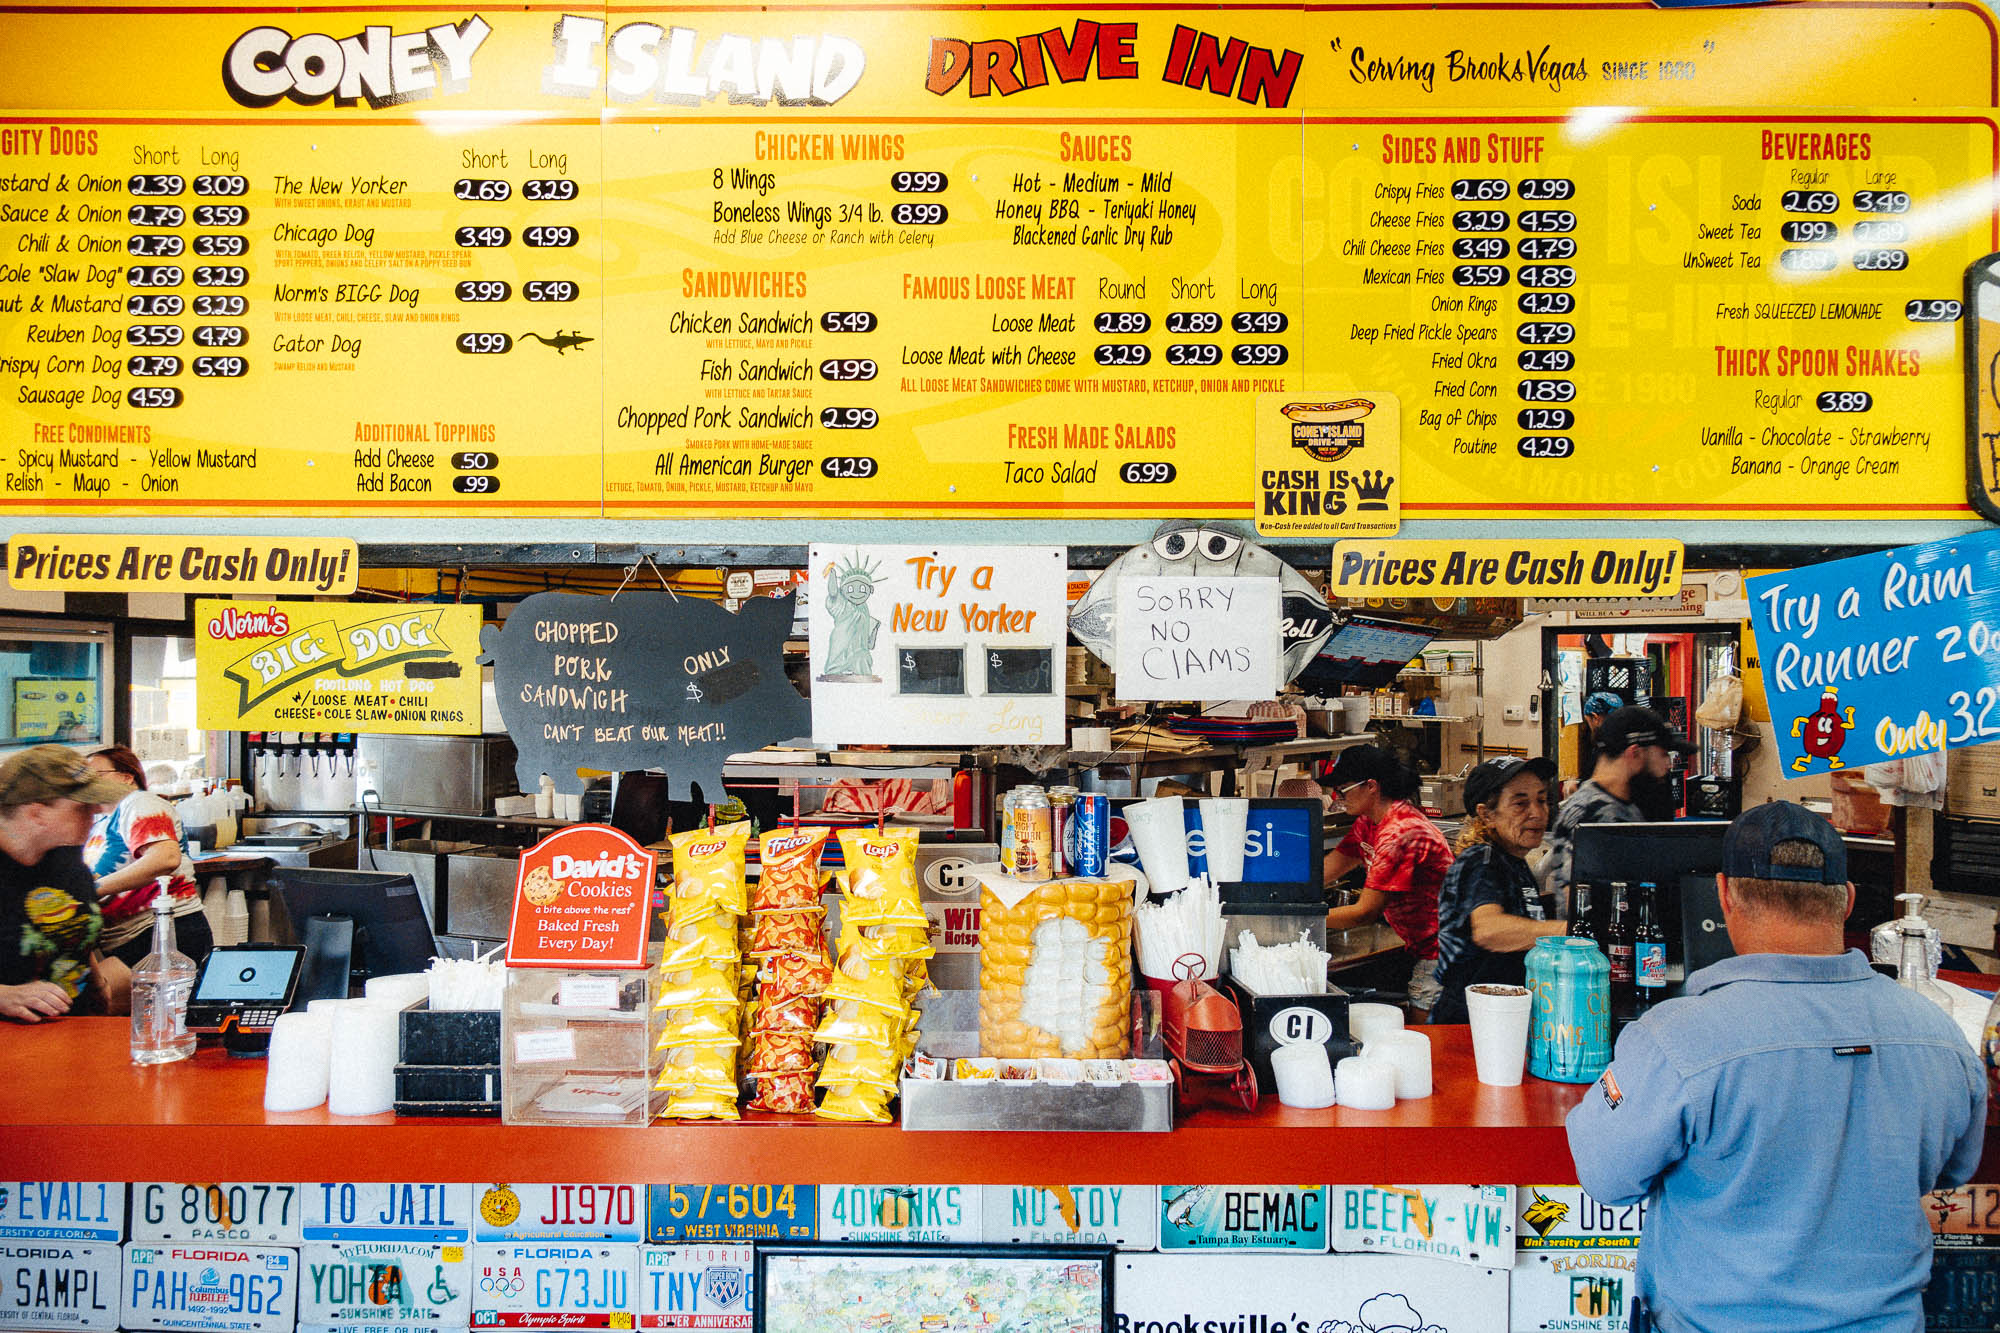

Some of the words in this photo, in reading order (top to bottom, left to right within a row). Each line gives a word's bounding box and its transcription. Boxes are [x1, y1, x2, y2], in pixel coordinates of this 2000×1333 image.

[223, 14, 492, 109] CONEY
[541, 14, 866, 107] ISLAND
[925, 19, 1138, 98] DRIVE
[1162, 24, 1303, 108] INN
[1602, 61, 1649, 81] SINCE
[51, 127, 98, 155] DOGS
[755, 131, 834, 160] CHICKEN
[842, 134, 905, 160] WINGS
[1060, 132, 1132, 162] SAUCES
[1383, 134, 1437, 164] SIDES
[1443, 138, 1480, 163] AND
[1488, 133, 1544, 163] STUFF
[1762, 130, 1871, 160] BEVERAGES
[274, 176, 302, 194] The
[310, 177, 342, 194] New
[351, 177, 408, 194] Yorker
[457, 180, 510, 200] 2.69
[528, 180, 573, 200] 3.29
[898, 205, 941, 223] 8.99
[1732, 195, 1761, 210] Soda
[1786, 193, 1838, 212] 2.69
[1855, 193, 1910, 212] 3.49
[714, 201, 780, 223] Boneless
[787, 203, 831, 229] Wings
[839, 204, 862, 222] 3/4
[869, 203, 884, 223] lb.
[18, 235, 50, 252] Chili
[57, 235, 69, 252] &
[78, 235, 122, 252] Onion
[714, 230, 735, 244] Add
[740, 230, 763, 244] Blue
[768, 230, 807, 244] Cheese
[813, 234, 825, 244] or
[830, 230, 864, 244] Ranch
[870, 230, 893, 244] with
[899, 230, 934, 248] Celery
[682, 268, 806, 297] SANDWICHES
[903, 274, 970, 300] FAMOUS
[976, 274, 1027, 300] LOOSE
[1031, 274, 1076, 300] MEAT
[1100, 277, 1146, 300] Round
[1171, 277, 1215, 298] Short
[1241, 278, 1277, 305] Long
[274, 285, 328, 302] Norm's
[336, 285, 382, 302] BIGG
[390, 284, 419, 307] Dog
[1351, 324, 1378, 344] Deep
[1384, 324, 1414, 340] Fried
[1419, 324, 1452, 340] Pickle
[1457, 324, 1497, 344] Spears
[1520, 324, 1573, 343] 4.79
[1715, 346, 1770, 376] THICK
[1777, 346, 1838, 376] SPOON
[1846, 346, 1920, 376] SHAKES
[920, 377, 949, 393] LOOSE
[952, 377, 977, 393] MEAT
[980, 377, 1042, 393] SANDWICHES
[1045, 377, 1071, 393] COME
[1074, 377, 1099, 393] WITH
[1101, 377, 1150, 395] MUSTARD,
[1153, 377, 1197, 395] KETCHUP,
[1200, 377, 1229, 393] ONION
[1232, 377, 1250, 393] AND
[1253, 377, 1285, 393] PICKLE
[355, 422, 430, 442] ADDITIONAL
[434, 422, 496, 442] TOPPINGS
[1262, 471, 1318, 489] CASH
[1329, 470, 1349, 489] IS
[1264, 491, 1347, 515] KING
[1304, 522, 1323, 530] added
[1324, 522, 1329, 530] to
[1331, 522, 1339, 530] all
[1340, 522, 1355, 530] Card
[1357, 522, 1396, 530] Transactions
[15, 546, 109, 579] Prices
[117, 547, 172, 579] Are
[180, 547, 256, 580] Cash
[266, 548, 350, 591] Only!
[906, 557, 956, 598] Try
[973, 566, 993, 590] a
[1338, 551, 1436, 585] Prices
[1442, 552, 1499, 585] Are
[1506, 551, 1584, 585] Cash
[1592, 550, 1677, 593] Only!
[1137, 586, 1234, 612] SORRY
[1760, 584, 1820, 639] Try
[1838, 587, 1859, 619] a
[1884, 562, 1974, 611] Rum
[209, 607, 288, 639] Norm's
[892, 603, 948, 632] New
[961, 603, 1036, 633] Yorker
[535, 621, 618, 643] CHOPPED
[1151, 621, 1190, 642] NO
[251, 630, 330, 687] BIG
[350, 617, 432, 663] DOG
[684, 646, 730, 675] ONLY
[1775, 635, 1919, 692] Runner
[555, 654, 612, 682] PORK
[521, 684, 628, 713] SANDWICH
[544, 724, 584, 743] CAN'T
[595, 725, 634, 742] BEAT
[642, 725, 669, 741] OUR
[678, 723, 726, 746] MEAT!!
[1875, 710, 1947, 756] Only
[691, 841, 724, 855] Lay's
[768, 836, 812, 856] Fritos
[865, 843, 898, 857] Lay's
[552, 851, 641, 880] David's
[567, 881, 632, 897] Cookies
[536, 906, 541, 914] a
[543, 905, 563, 914] bite
[565, 905, 591, 914] above
[593, 905, 610, 914] the
[537, 919, 579, 932] Baked
[583, 919, 619, 932] Fresh
[538, 937, 577, 953] Every
[581, 937, 613, 954] Day!
[1286, 1015, 1313, 1040] CI
[145, 1185, 164, 1224] G
[181, 1186, 295, 1226] 80077
[1225, 1192, 1318, 1232] BEMAC
[192, 1230, 250, 1240] PASCO
[513, 1231, 561, 1240] Agricultural
[563, 1230, 605, 1239] Education
[685, 1225, 721, 1237] WEST
[725, 1225, 779, 1238] VIRGINIA
[849, 1231, 902, 1242] SUNSHINE
[908, 1230, 943, 1242] STATE
[1197, 1235, 1227, 1246] Tampa
[1231, 1235, 1249, 1247] Bay
[1251, 1235, 1289, 1247] Estuary
[172, 1250, 250, 1263] FLORIDA
[514, 1248, 592, 1259] FLORIDA
[17, 1268, 107, 1310] SAMPL
[133, 1270, 188, 1310] PAH
[190, 1286, 229, 1294] Columbus
[536, 1269, 627, 1308] G73JU
[162, 1319, 227, 1329] QUINCENTENNIAL
[230, 1321, 251, 1330] STATE
[519, 1313, 555, 1326] Olympic
[559, 1314, 586, 1325] Spirit
